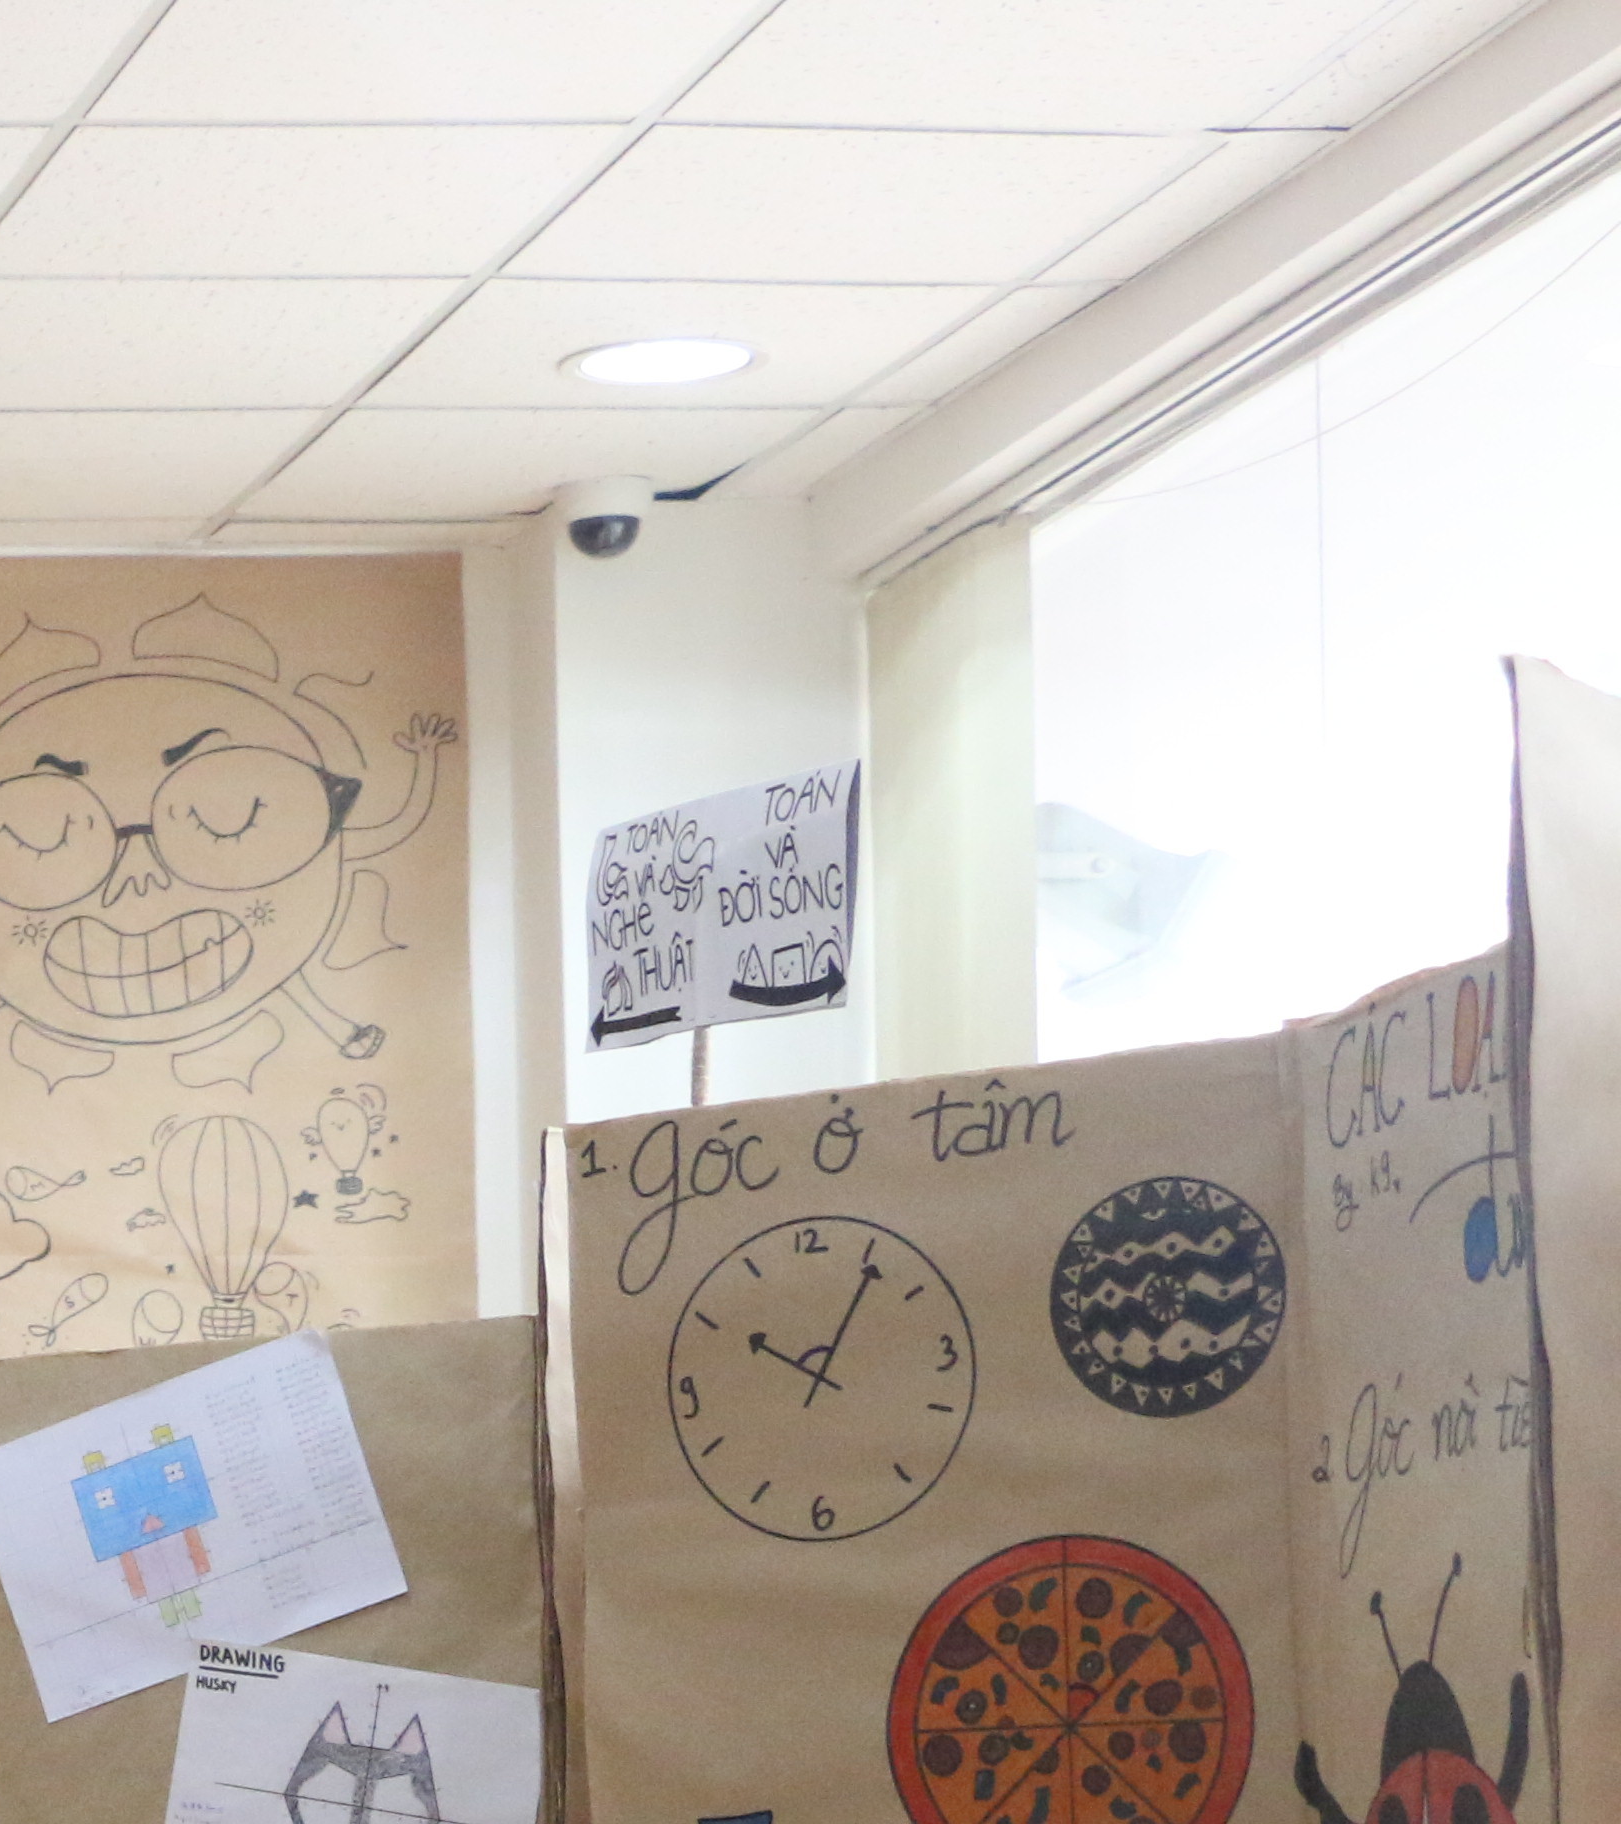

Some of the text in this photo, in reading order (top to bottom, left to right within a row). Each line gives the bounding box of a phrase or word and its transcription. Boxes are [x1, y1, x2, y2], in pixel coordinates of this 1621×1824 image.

[911, 1078, 1077, 1162] tâm
[793, 1228, 830, 1254] 12
[937, 1334, 958, 1372] 3
[679, 1376, 700, 1418] 9
[811, 1495, 835, 1531] 6
[198, 1643, 286, 1674] DRAWING
